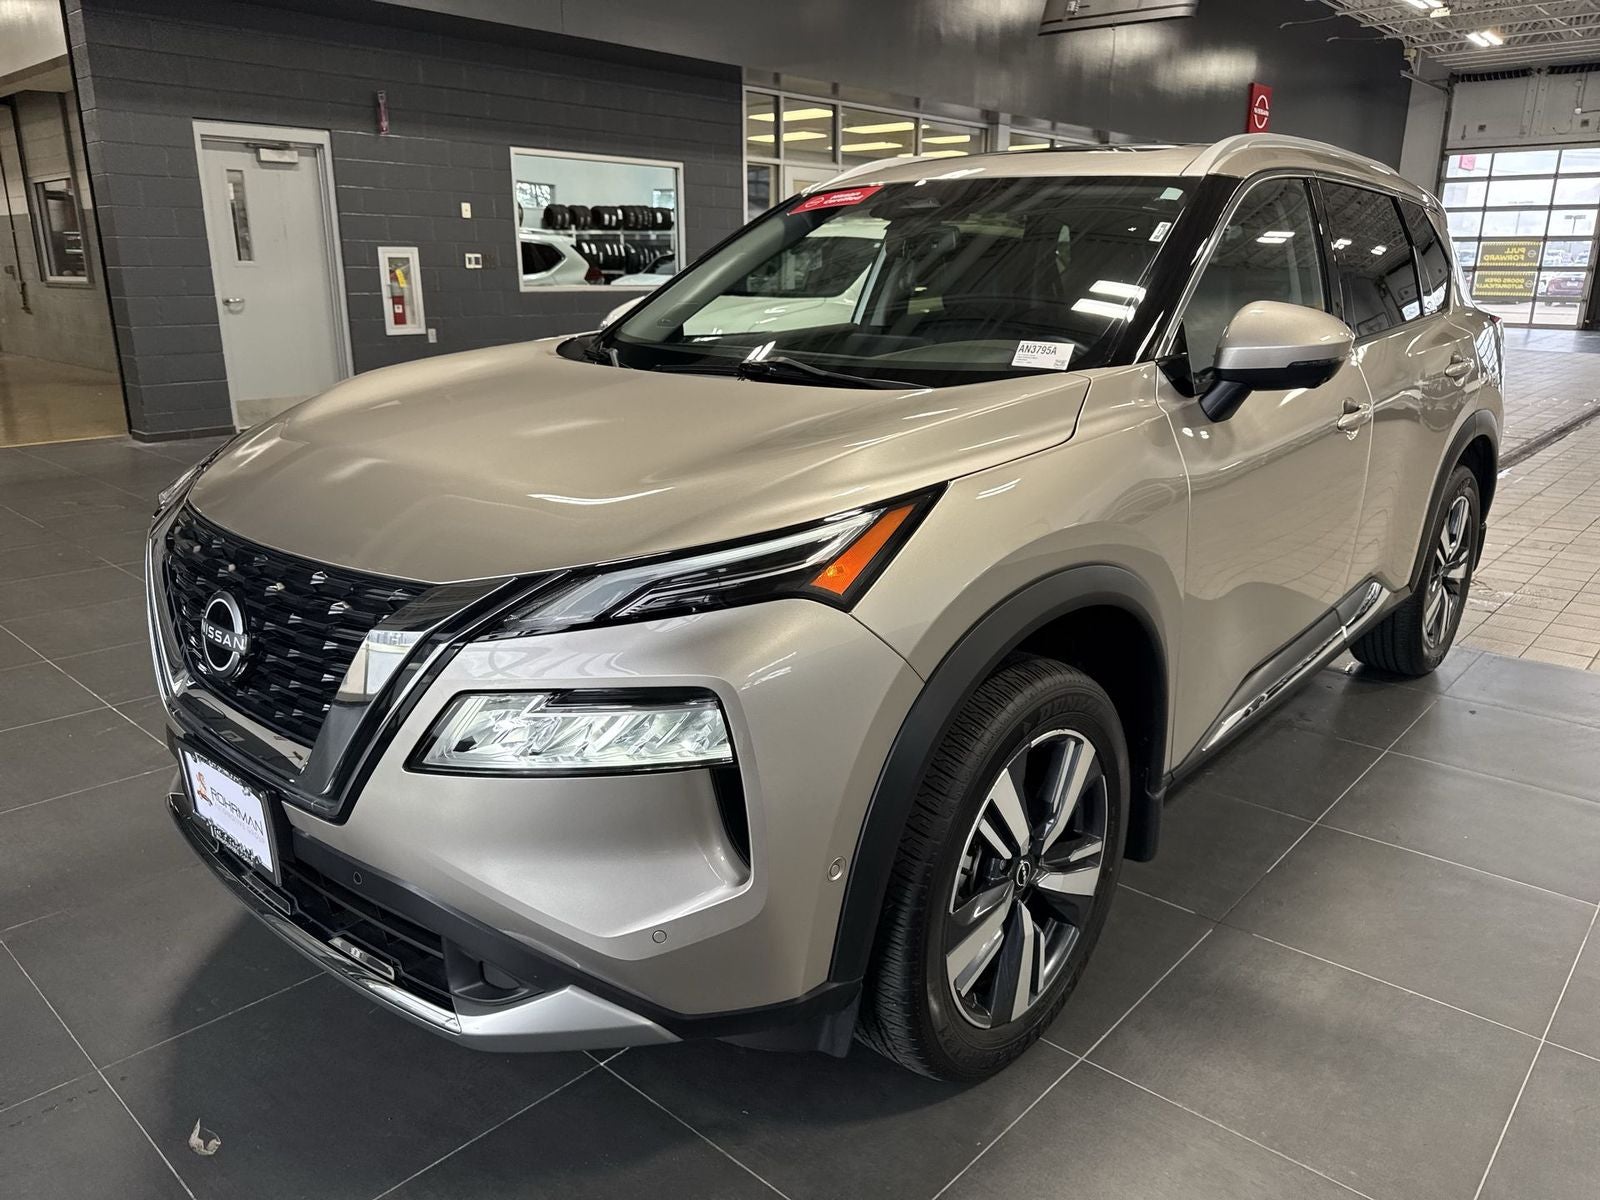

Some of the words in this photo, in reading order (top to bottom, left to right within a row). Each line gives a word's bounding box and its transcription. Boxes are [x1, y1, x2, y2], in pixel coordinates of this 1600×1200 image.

[1018, 344, 1057, 355] AN3795A
[201, 618, 248, 652] NISSAN
[210, 786, 264, 836] ROHRMAN
